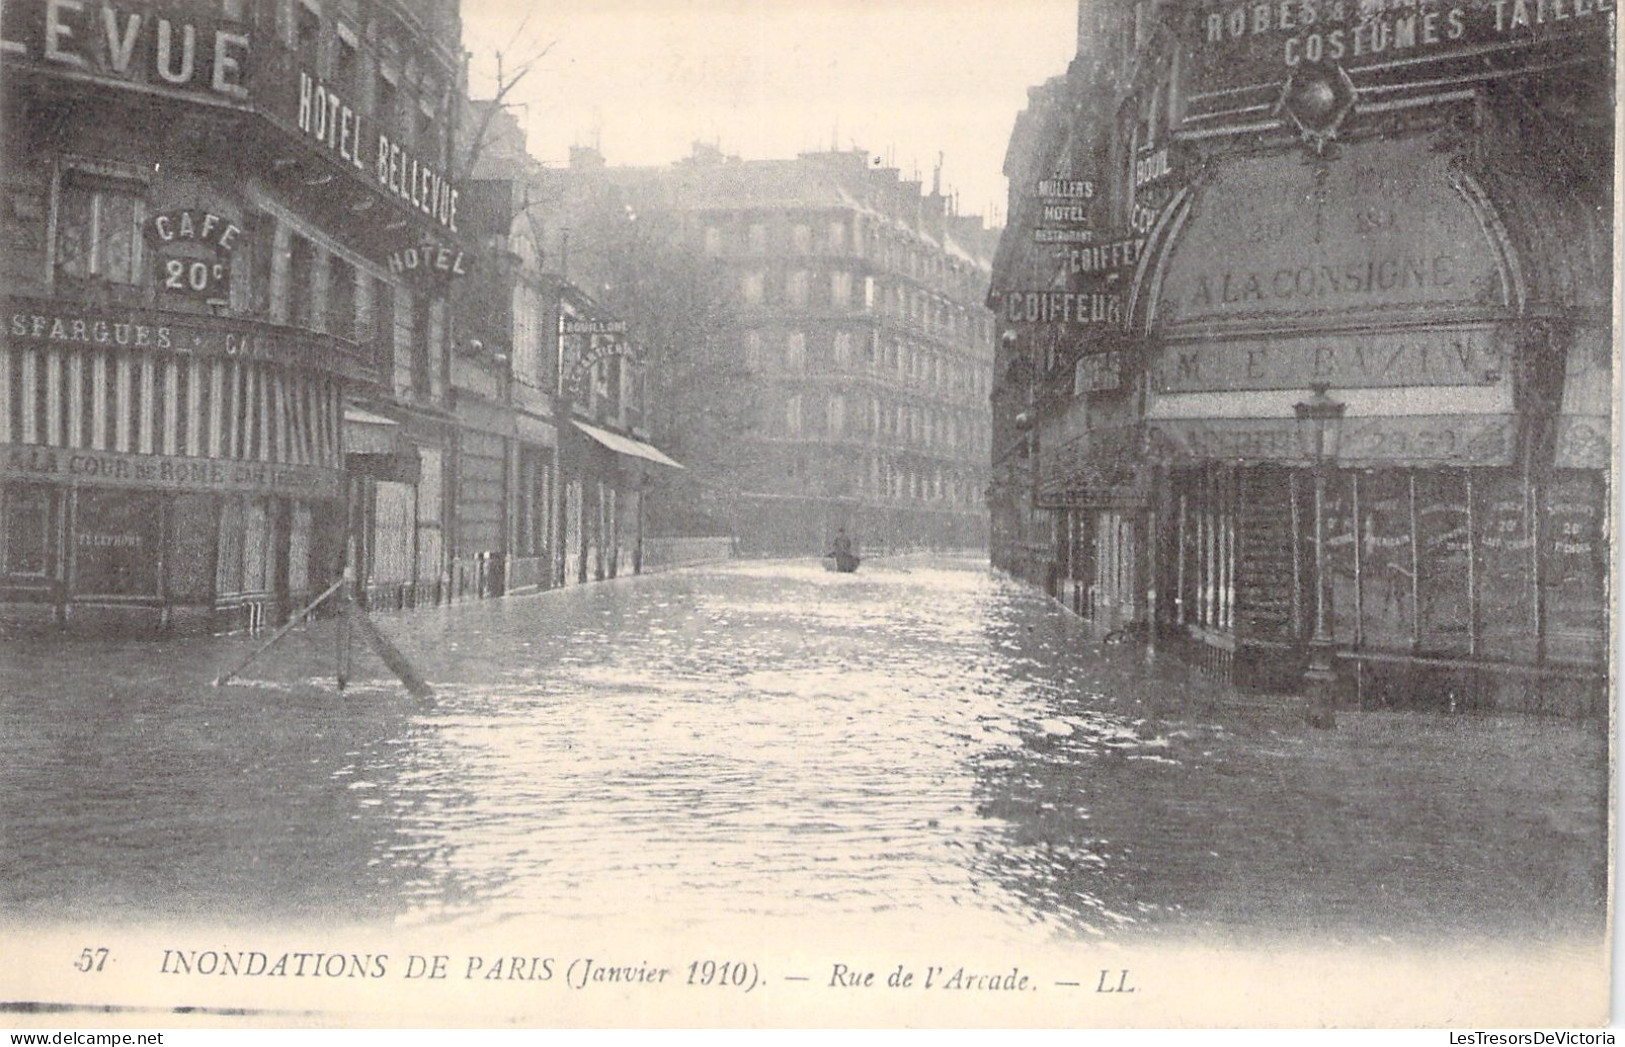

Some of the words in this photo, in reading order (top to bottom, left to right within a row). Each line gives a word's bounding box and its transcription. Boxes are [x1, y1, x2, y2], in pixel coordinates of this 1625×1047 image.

[1207, 3, 1315, 41] ROBES
[1284, 9, 1465, 66] COSTUMES
[0, 0, 250, 98] EVUE
[379, 135, 458, 233] BELLEVUE
[155, 212, 241, 250] CAFE
[1044, 206, 1086, 221] HOTEL
[386, 246, 465, 275] HOTEL
[1271, 254, 1454, 299] CONSIGNE
[1008, 292, 1121, 323] COIFFEUR
[69, 455, 129, 479] COUR
[160, 461, 224, 483] ROME
